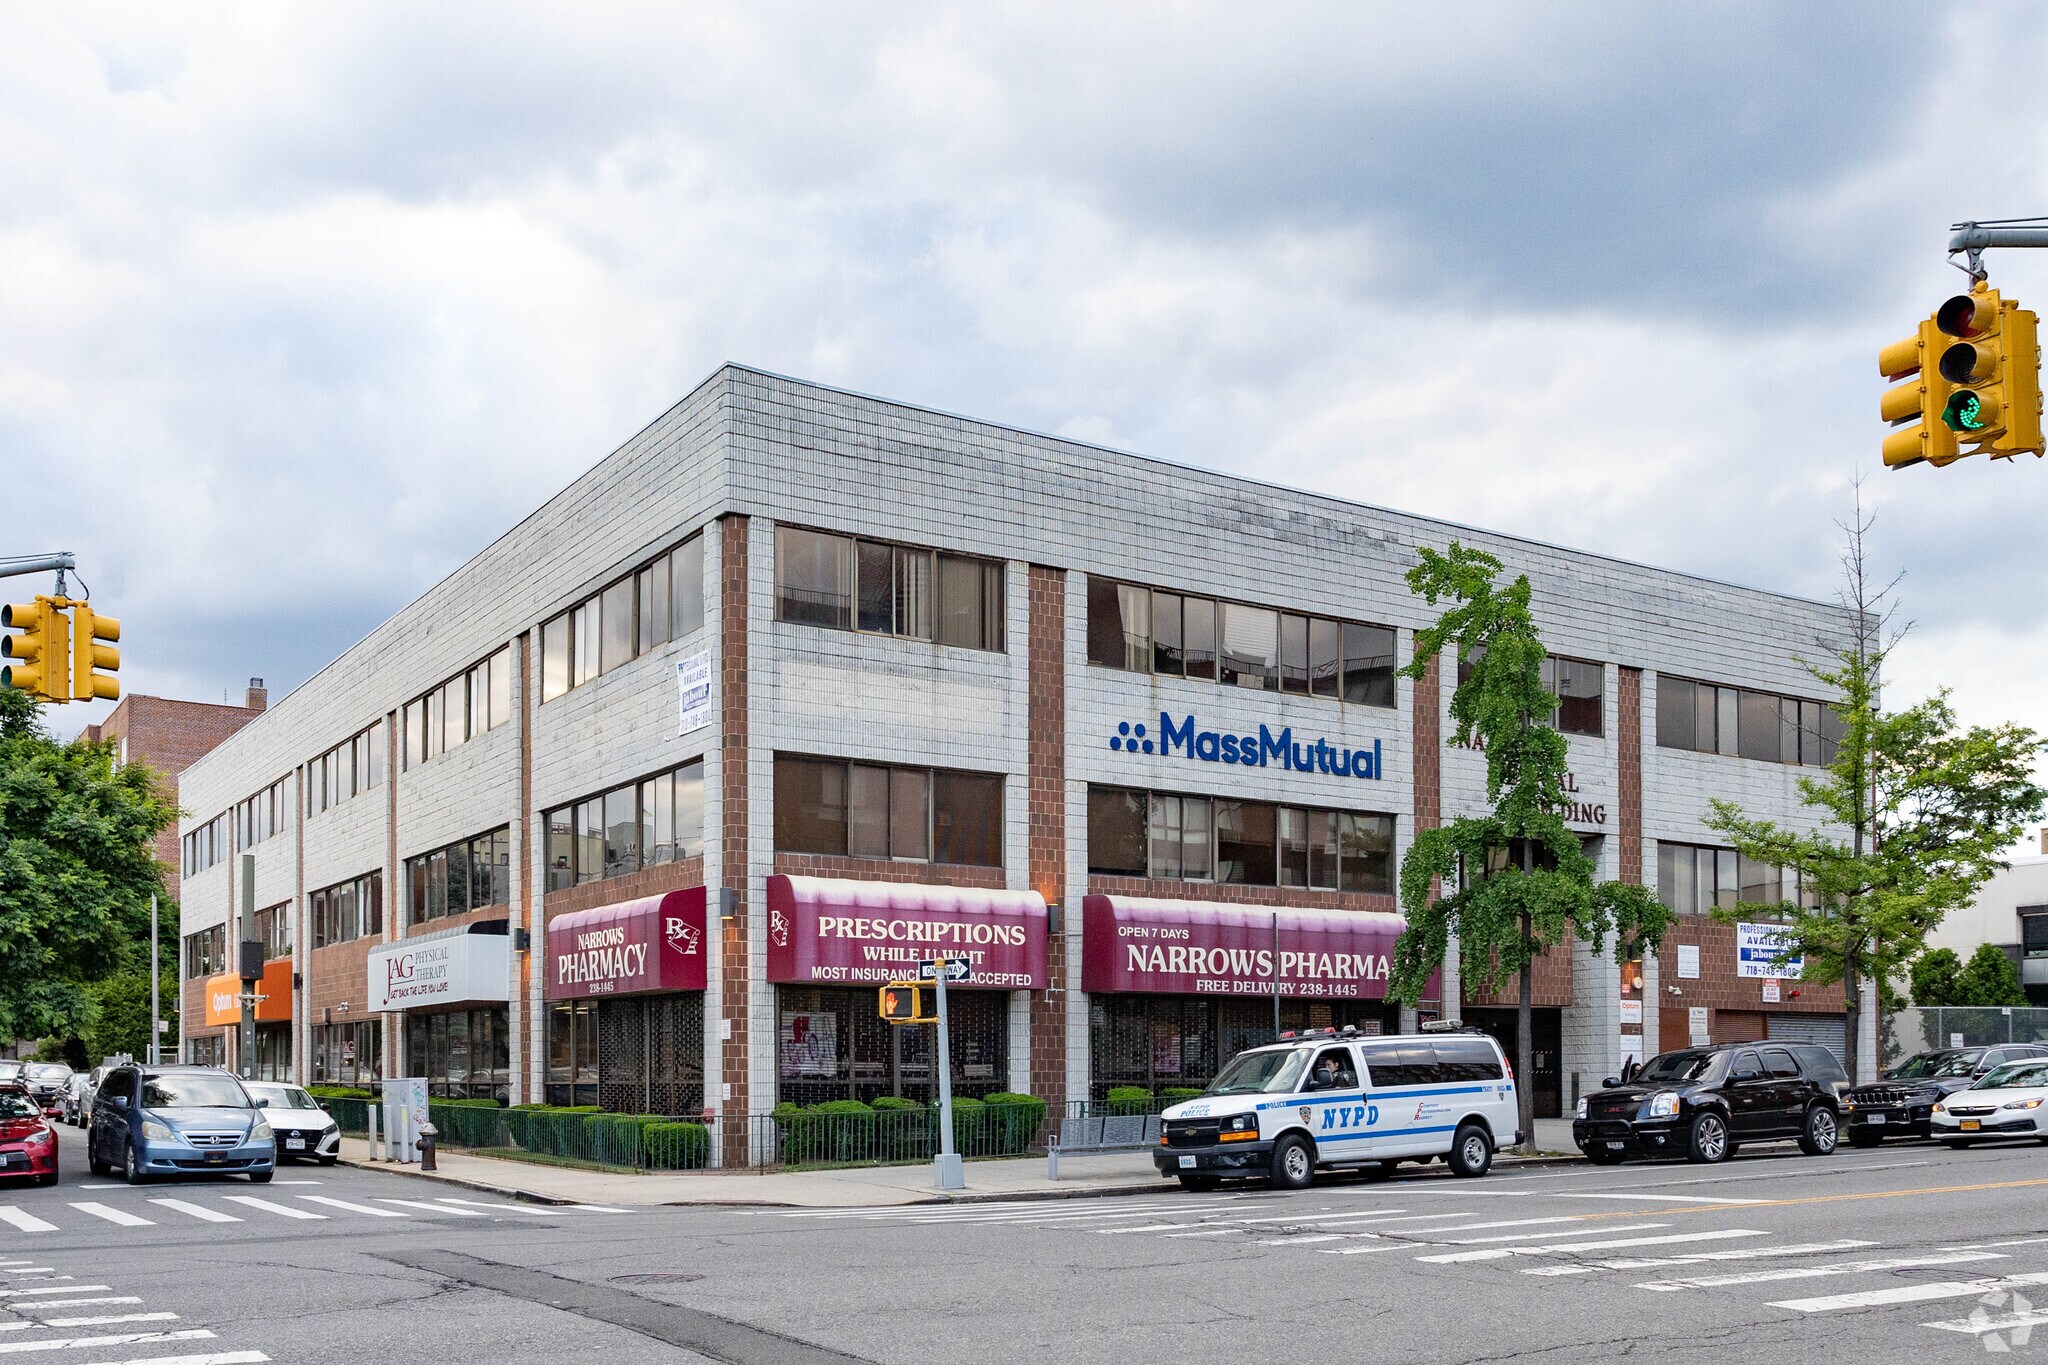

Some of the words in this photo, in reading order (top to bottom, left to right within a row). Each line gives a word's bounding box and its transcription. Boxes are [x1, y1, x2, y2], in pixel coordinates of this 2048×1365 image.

[1160, 711, 1382, 780] MassMutual
[577, 926, 625, 951] NARROWS
[818, 916, 1026, 946] PRESCRIPTIONS
[1118, 926, 1149, 938] OPEN
[1151, 928, 1158, 938] 7
[1160, 928, 1190, 940] DAYS
[1740, 925, 1778, 934] PROFESSIONA
[415, 946, 449, 965] PHYSICAL
[558, 943, 648, 985] PHARMACY
[863, 946, 919, 962] WHILE
[925, 948, 937, 960] U
[942, 949, 985, 965] WAIT
[1127, 944, 1273, 977] NARROWS
[1280, 951, 1392, 981] PHARMA
[383, 954, 415, 1006] JAG
[416, 964, 448, 981] THERAPY
[811, 966, 848, 980] MOST
[969, 971, 1032, 986] ACCEPTED
[926, 966, 938, 976] ON
[948, 965, 963, 975] WAY
[589, 981, 614, 993] 238-1445
[1196, 979, 1229, 992] FREE
[1300, 982, 1358, 996] 238-1445
[1622, 1002, 1640, 1010] Optum
[1180, 1108, 1211, 1118] POLICE
[1267, 1101, 1287, 1110] POLICE
[1322, 1105, 1379, 1130] NYPD
